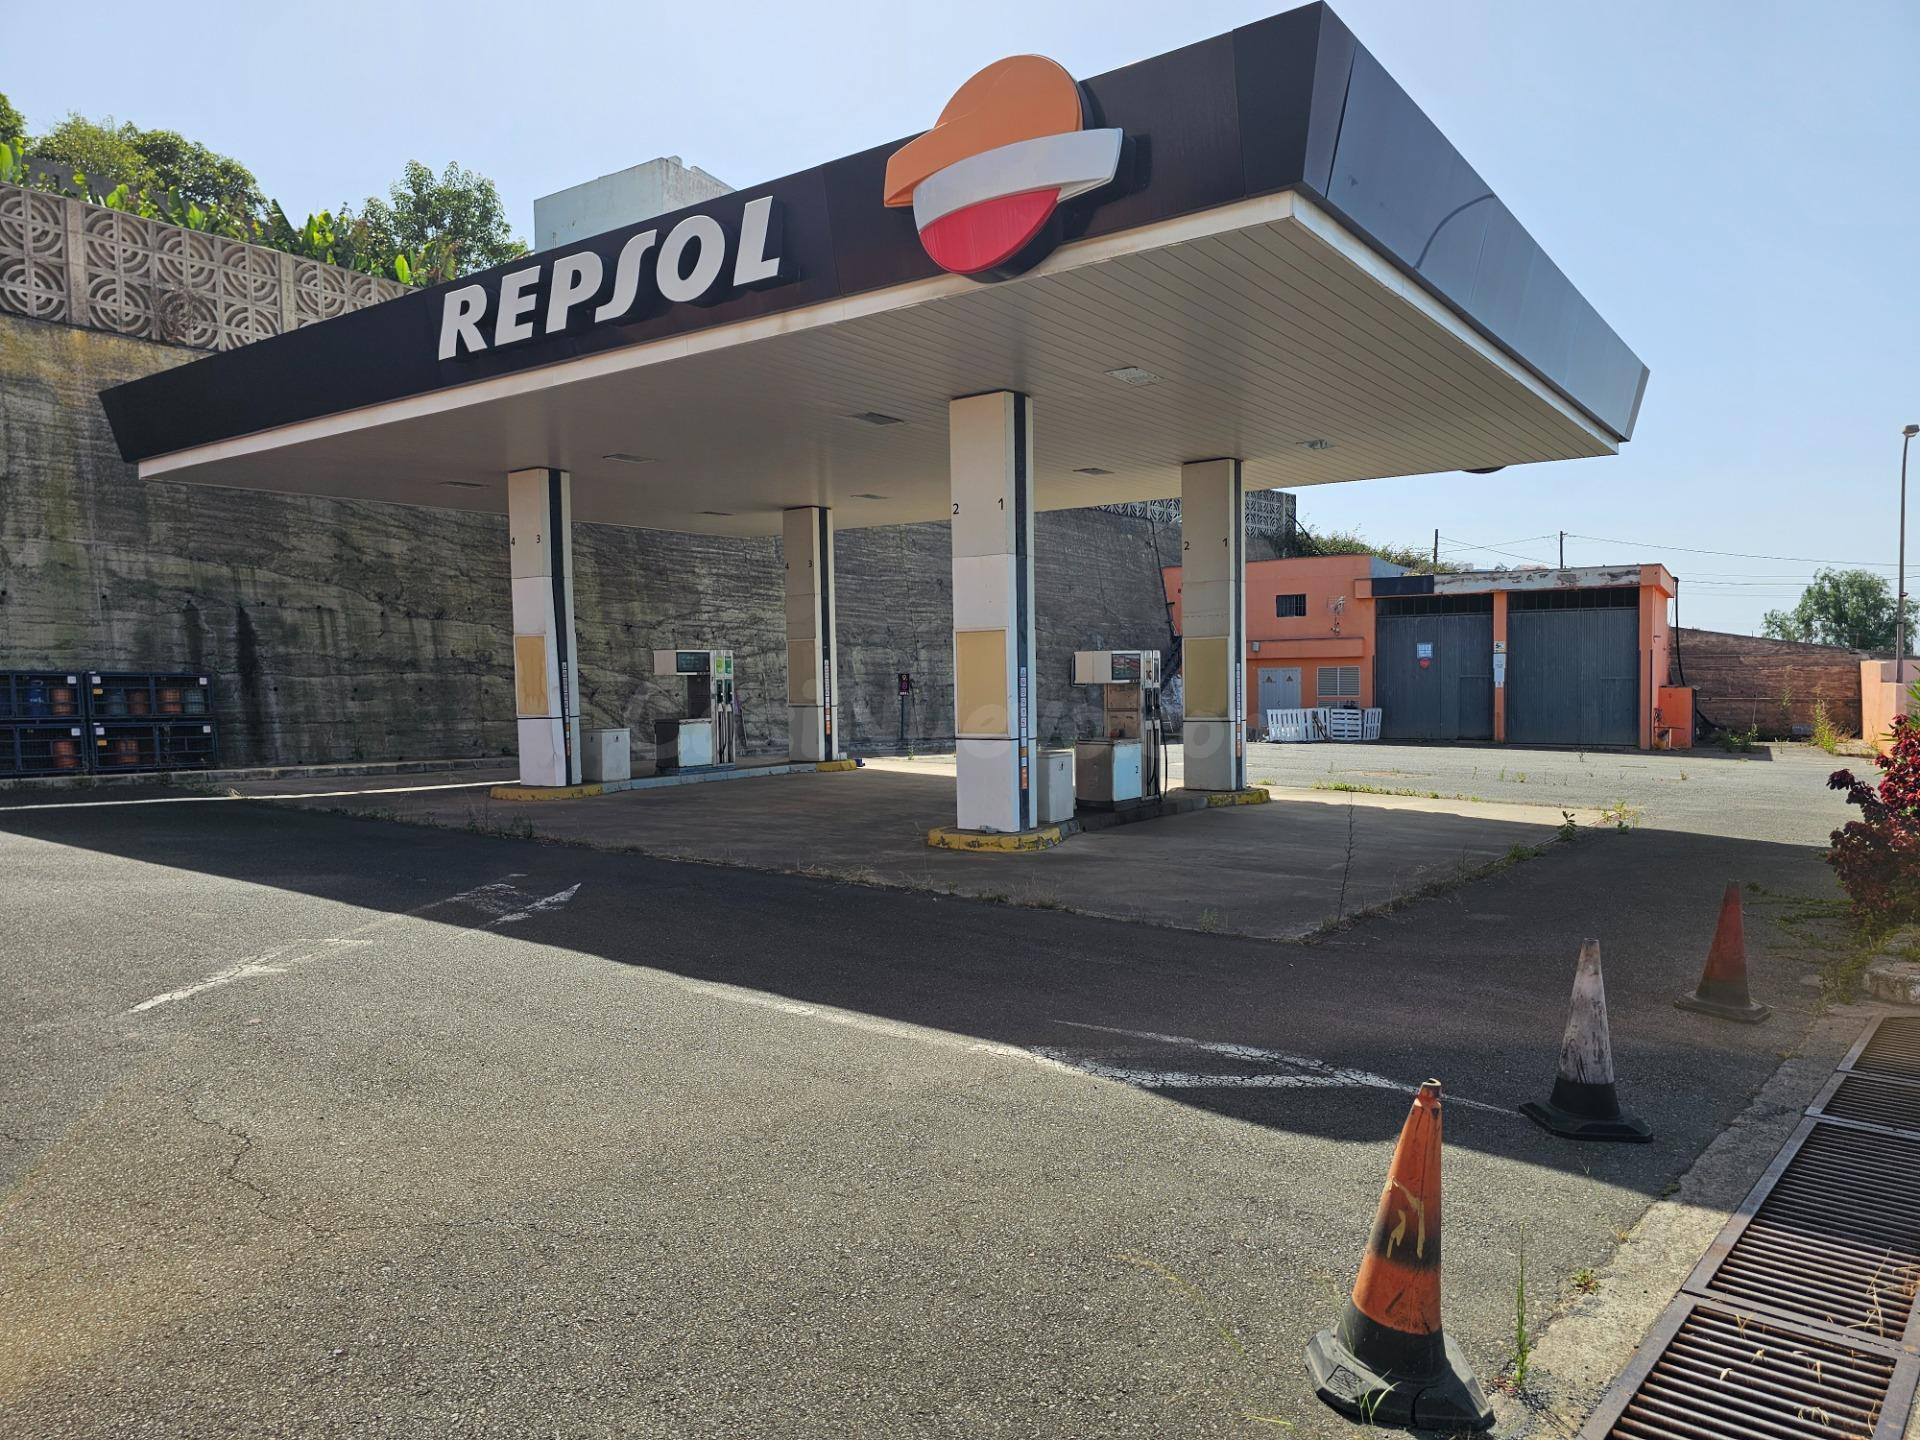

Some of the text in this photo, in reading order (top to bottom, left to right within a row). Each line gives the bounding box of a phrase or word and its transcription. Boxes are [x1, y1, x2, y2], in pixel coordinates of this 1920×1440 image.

[438, 196, 780, 361] REPSOL
[952, 503, 960, 515] 2
[998, 497, 1004, 511] 1
[536, 534, 541, 544] 3
[1222, 537, 1228, 548] 1
[1184, 541, 1190, 551] 2
